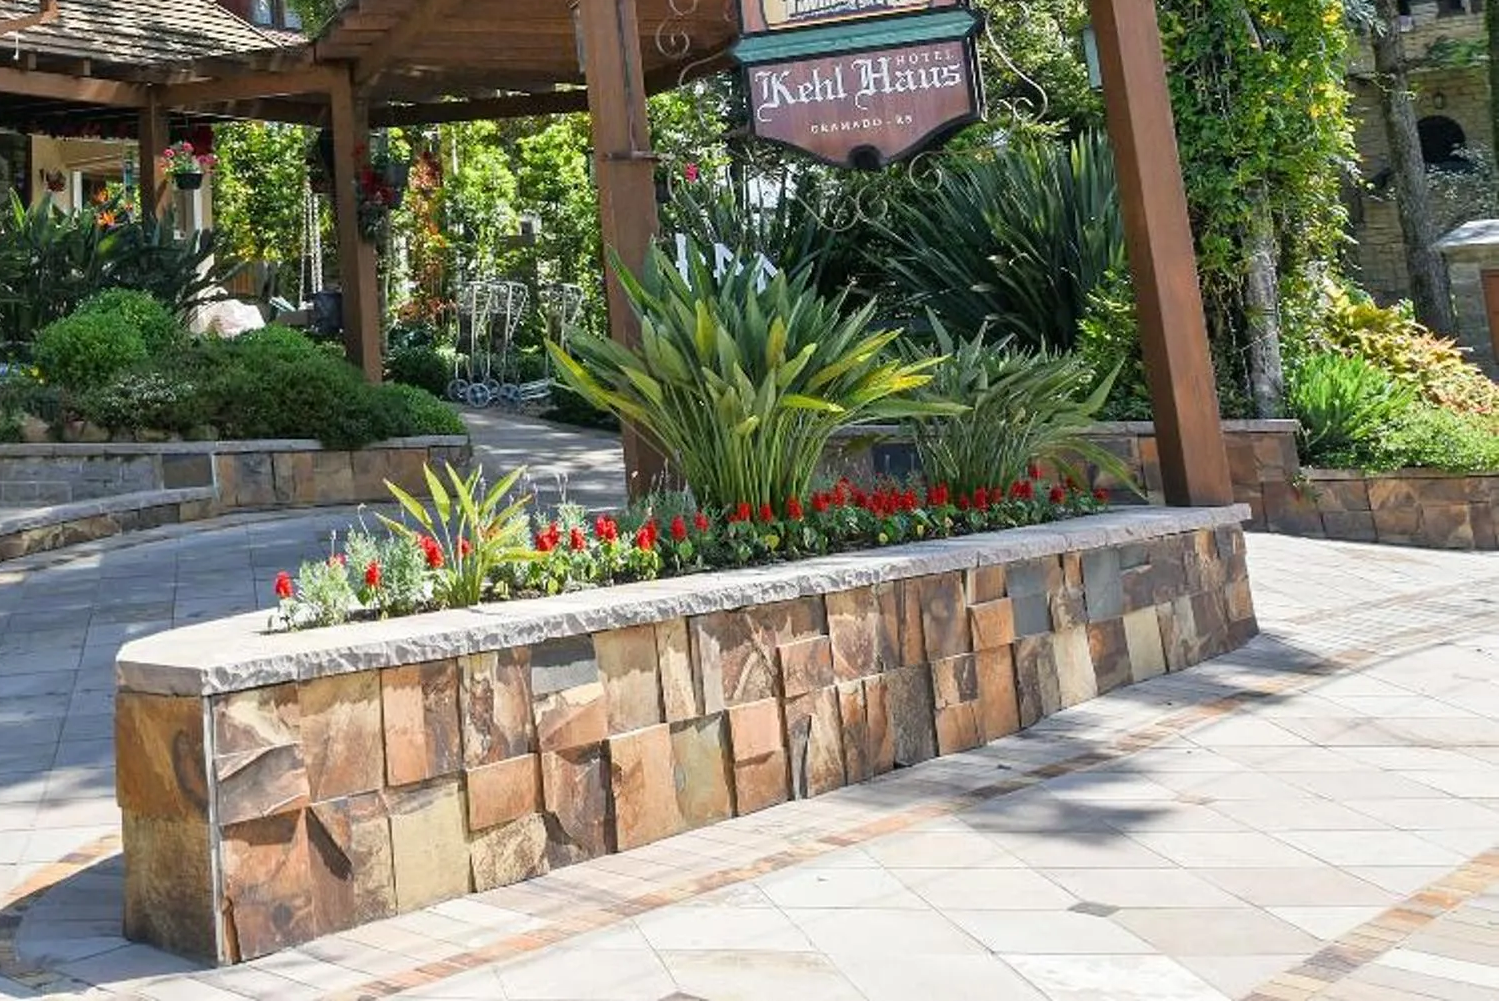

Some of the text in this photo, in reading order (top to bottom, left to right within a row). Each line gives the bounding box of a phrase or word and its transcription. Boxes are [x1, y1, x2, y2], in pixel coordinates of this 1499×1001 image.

[894, 49, 954, 66] HOTEL
[754, 56, 962, 122] Kehl Haus
